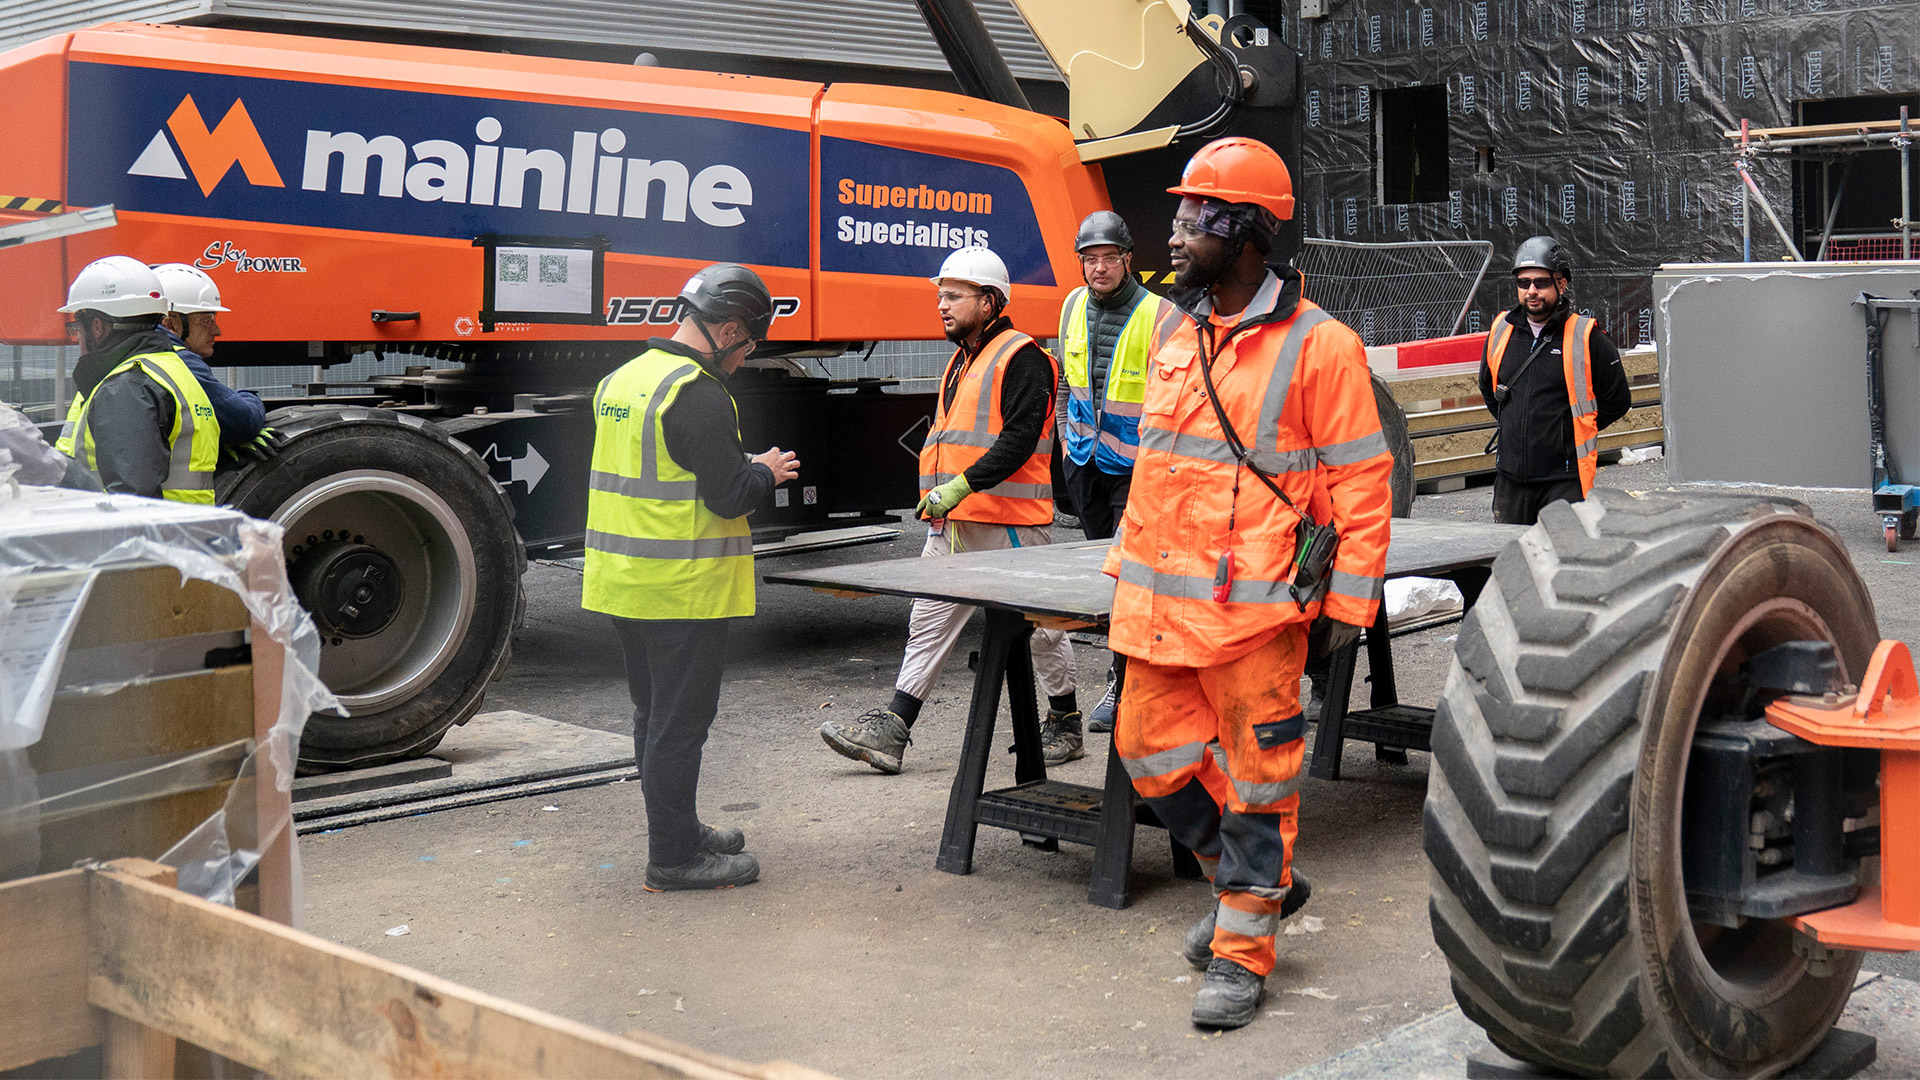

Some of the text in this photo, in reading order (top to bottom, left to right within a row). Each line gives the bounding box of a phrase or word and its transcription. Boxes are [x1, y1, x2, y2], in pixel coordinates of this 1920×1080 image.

[1371, 15, 1381, 53] EFFISUS
[1423, 8, 1434, 47] EFFISUS
[1477, 1, 1488, 41] EFFISUS
[1578, 66, 1589, 107] EFFISUS
[1679, 61, 1690, 103] EFFISUS
[1743, 56, 1755, 99] EFFISUS
[1810, 51, 1823, 94] EFFISUS
[1879, 46, 1892, 90] EFFISUS
[1310, 91, 1320, 127] EFFISUS
[1464, 75, 1475, 115] EFFISUS
[1520, 71, 1531, 111] EFFISUS
[302, 116, 753, 228] mainline
[838, 178, 992, 214] Superboom
[1506, 187, 1518, 227] EFFISUS
[1564, 184, 1576, 225] EFFISUS
[1624, 181, 1636, 222] EFFISUS
[837, 215, 989, 249] Specialists
[1347, 198, 1358, 236] EFFISUS
[1400, 204, 1409, 232] FISUS
[1639, 309, 1650, 344] FFISUS
[601, 403, 630, 422] Errigal
